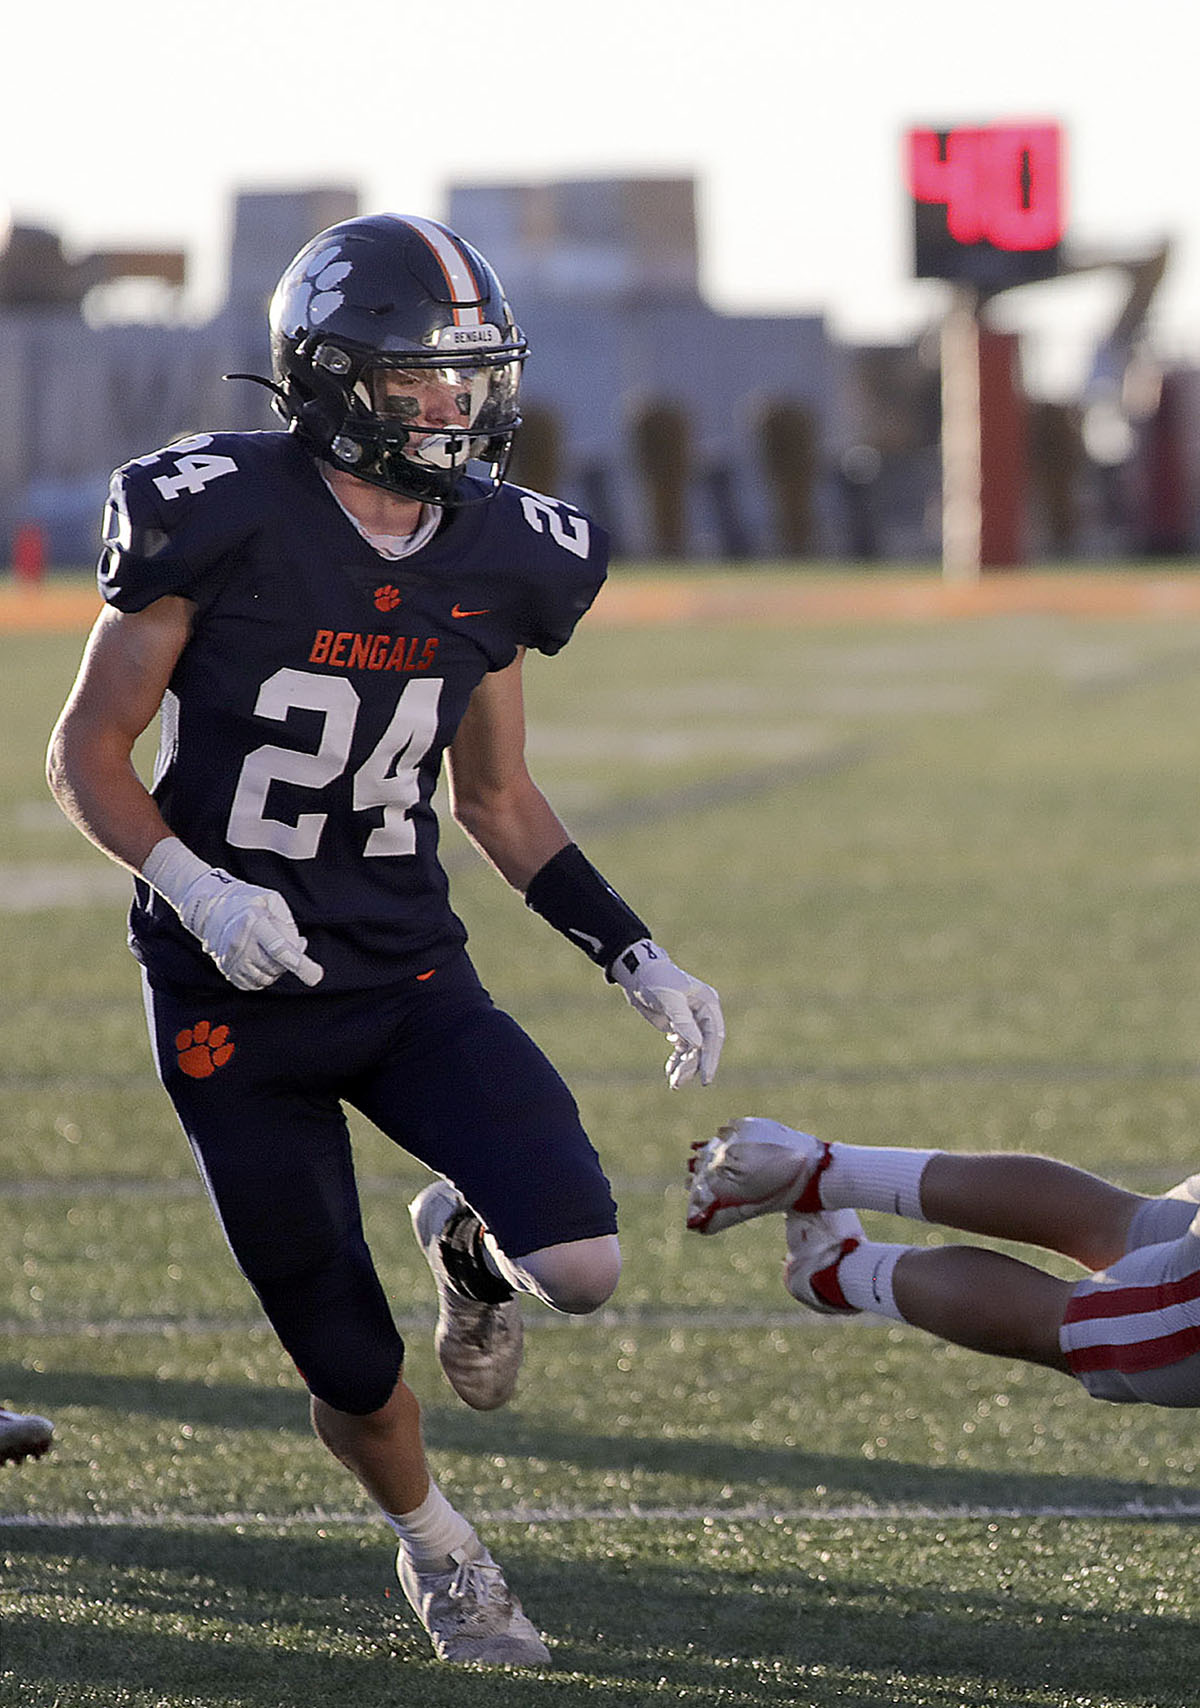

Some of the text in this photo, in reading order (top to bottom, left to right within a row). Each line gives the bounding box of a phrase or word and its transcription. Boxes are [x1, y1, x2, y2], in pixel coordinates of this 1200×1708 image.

[903, 120, 1066, 251] 40
[454, 330, 492, 343] BENGALS
[308, 629, 440, 672] BENGALS
[226, 667, 444, 859] 24
